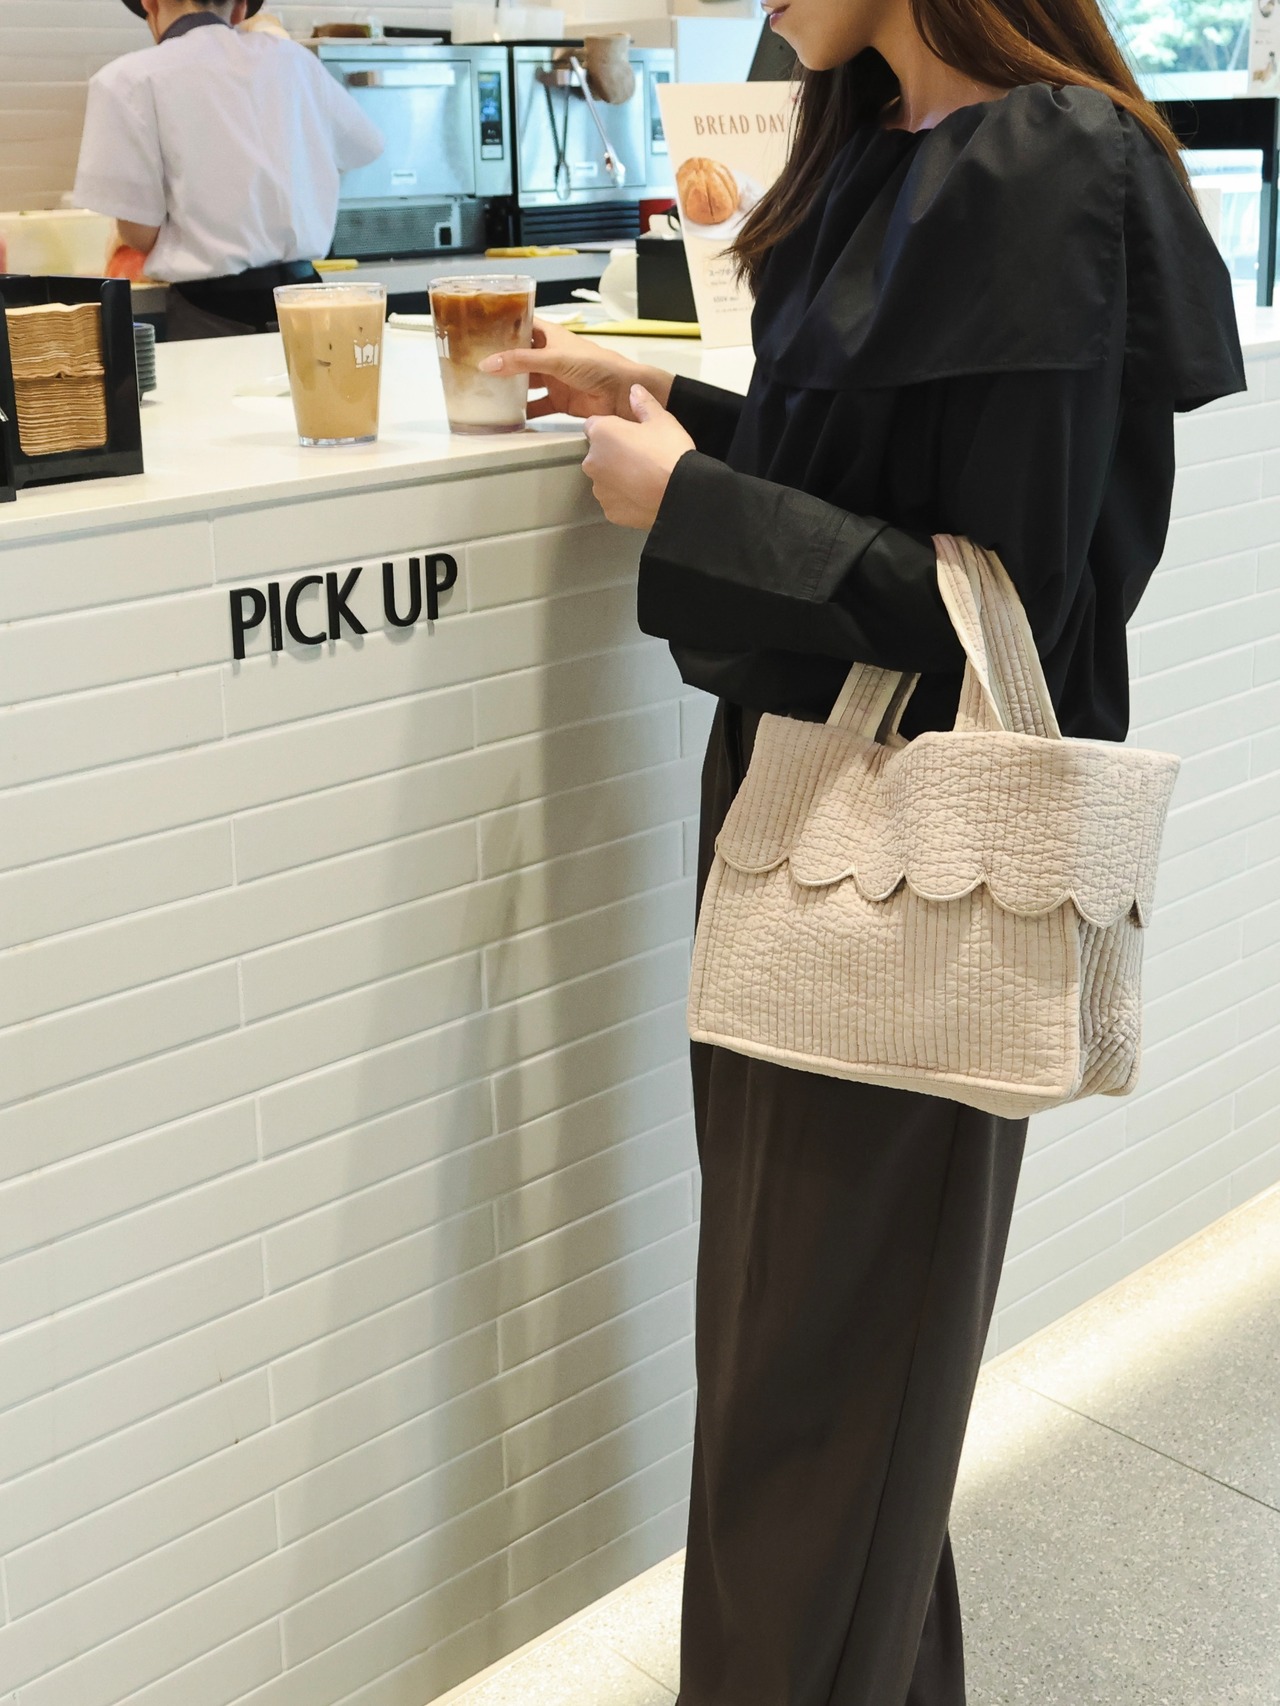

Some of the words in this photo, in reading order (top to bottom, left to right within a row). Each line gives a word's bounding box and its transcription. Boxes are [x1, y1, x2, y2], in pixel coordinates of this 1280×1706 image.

[694, 115, 749, 135] BREAD
[756, 113, 785, 133] DAY
[229, 567, 368, 660] PICK
[382, 553, 458, 628] UP
